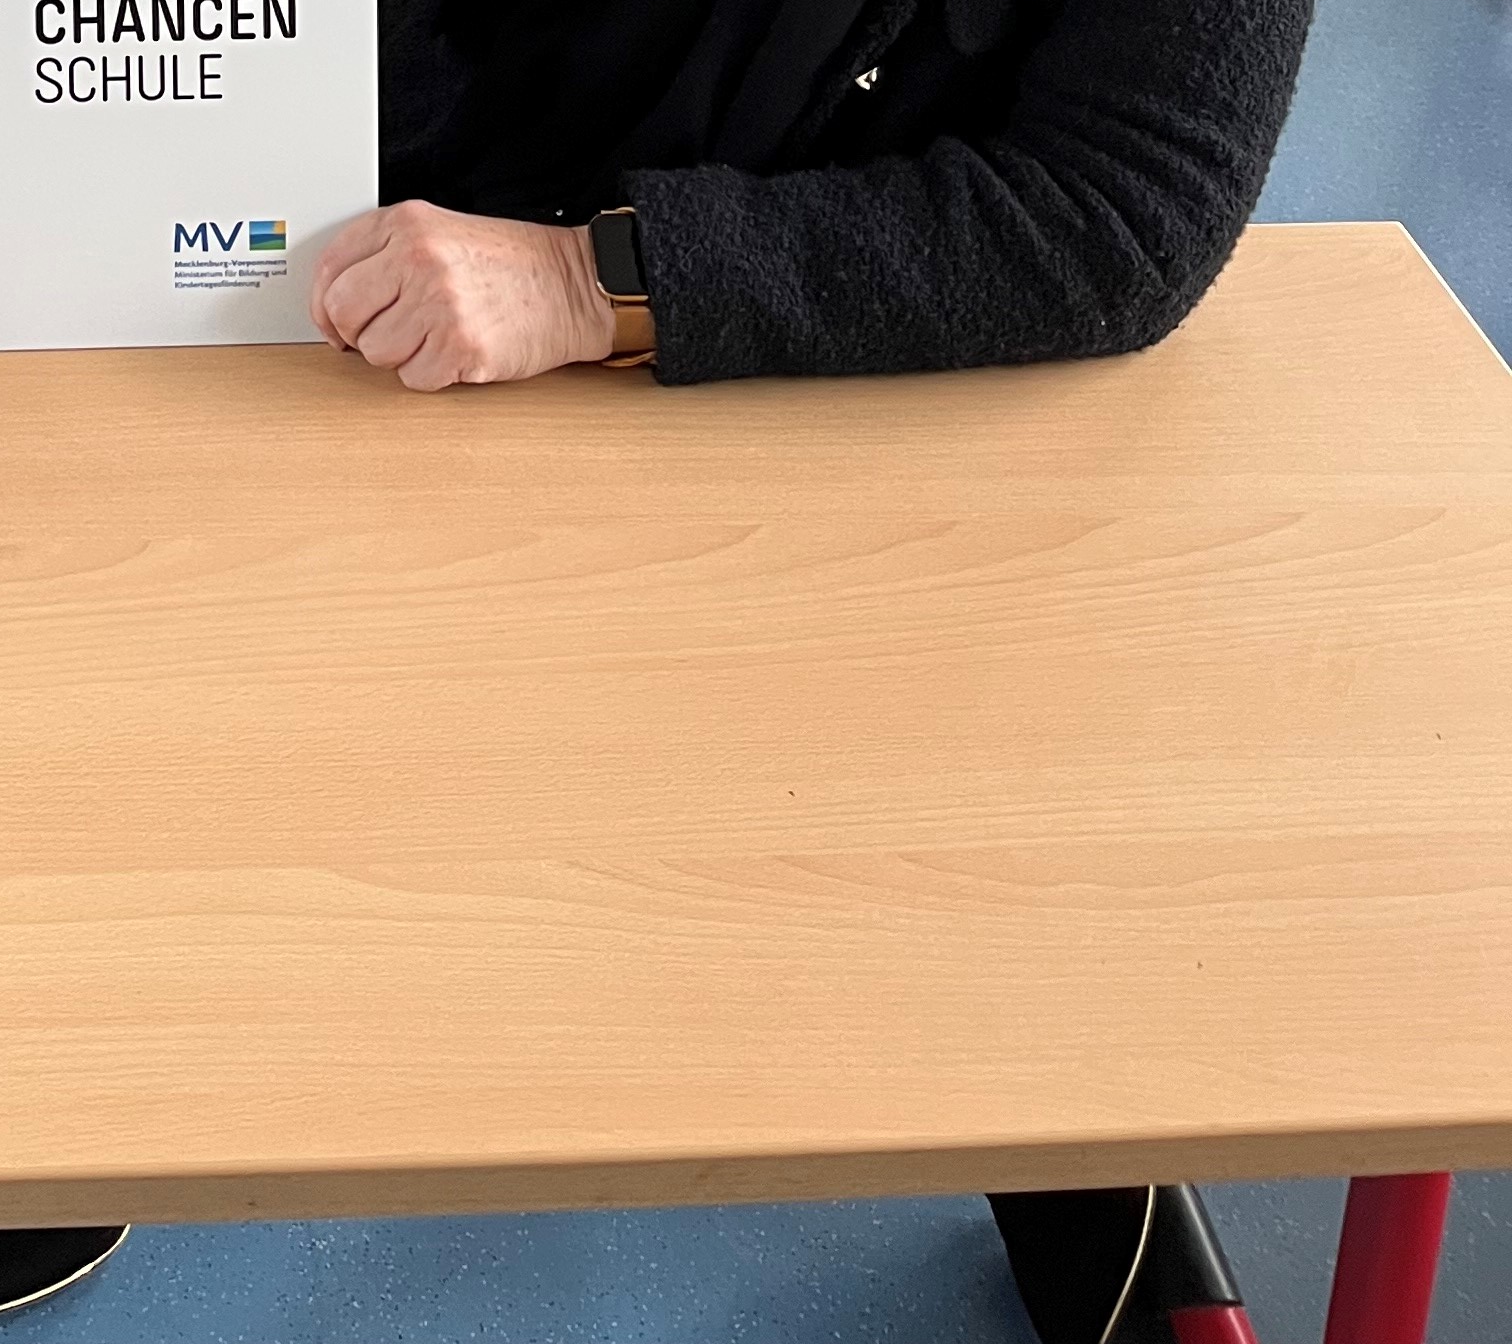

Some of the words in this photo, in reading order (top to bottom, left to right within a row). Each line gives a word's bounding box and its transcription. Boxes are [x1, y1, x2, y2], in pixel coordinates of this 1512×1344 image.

[35, 53, 222, 103] SCHULE
[174, 220, 244, 253] MV
[174, 260, 286, 268] Mecklenburg-Vorpommern
[239, 270, 269, 278] Bildung
